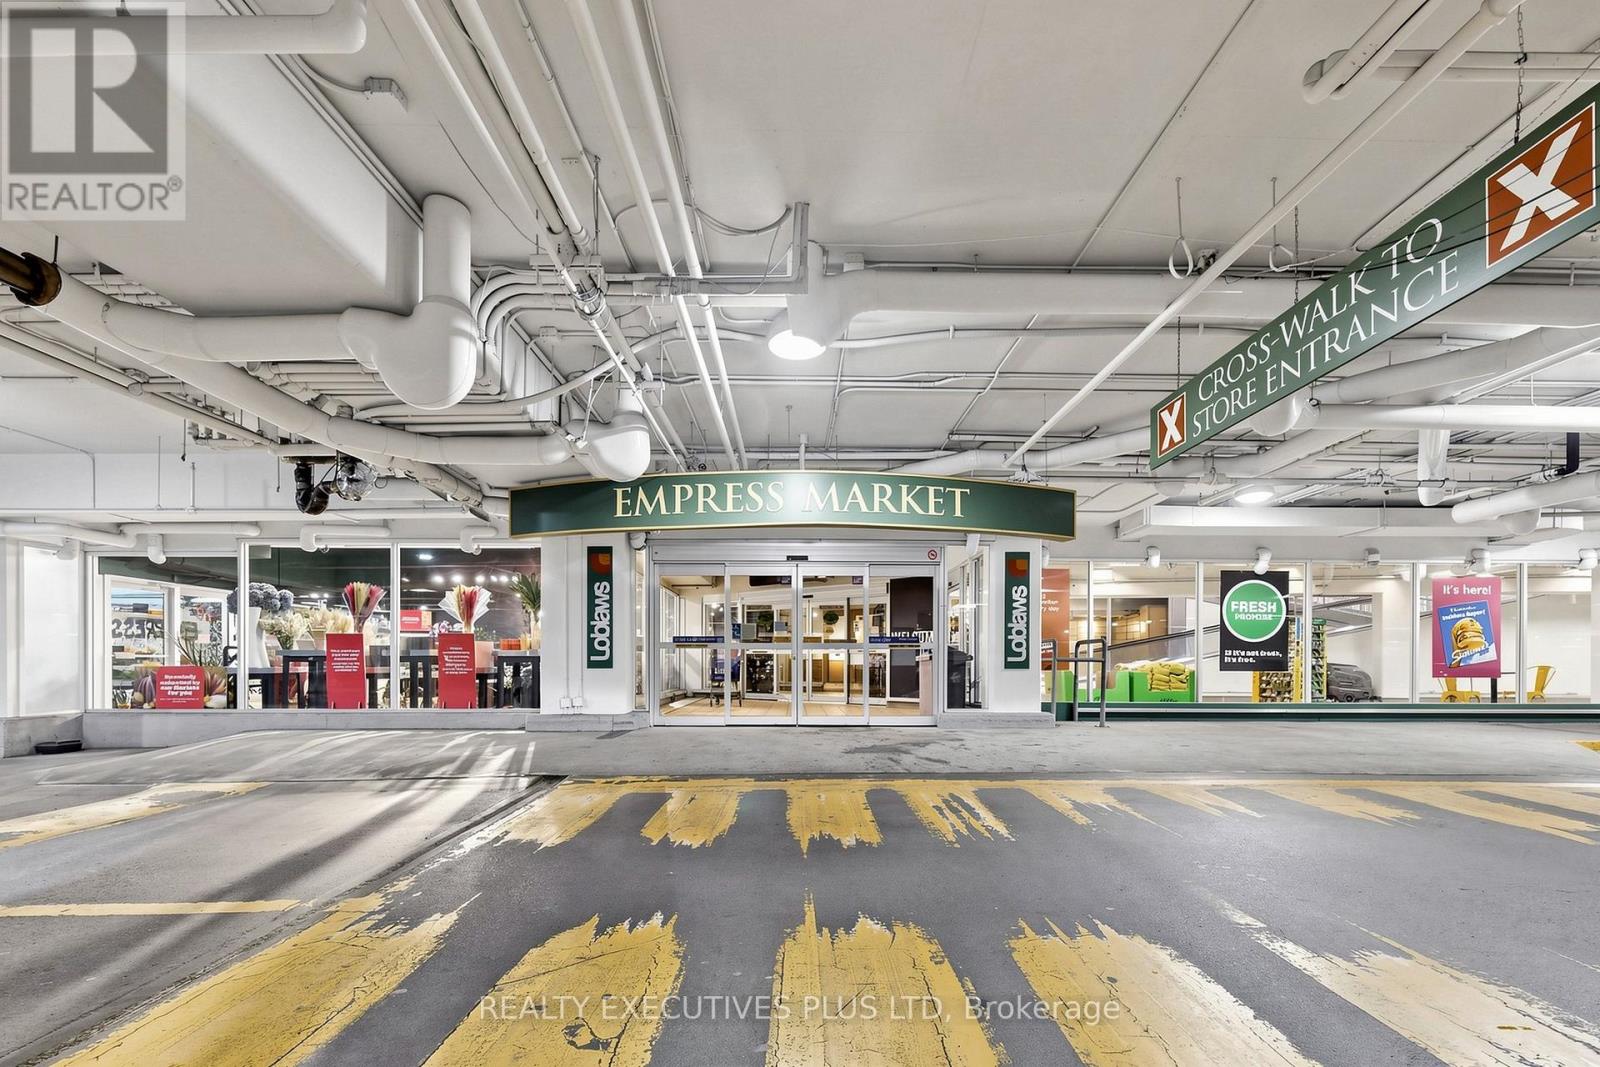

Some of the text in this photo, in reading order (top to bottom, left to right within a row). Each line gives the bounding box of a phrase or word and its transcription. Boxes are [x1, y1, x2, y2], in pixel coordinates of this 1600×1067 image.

[1192, 249, 1459, 438] STORE ENTRANCE
[1198, 217, 1444, 402] CROSS-WALK TO
[613, 481, 971, 518] EMPRESS MARKET
[590, 581, 611, 661] Loblaws
[1007, 585, 1028, 662] Loblaws
[1230, 600, 1277, 613] FRESH
[1443, 583, 1492, 595] It's here!
